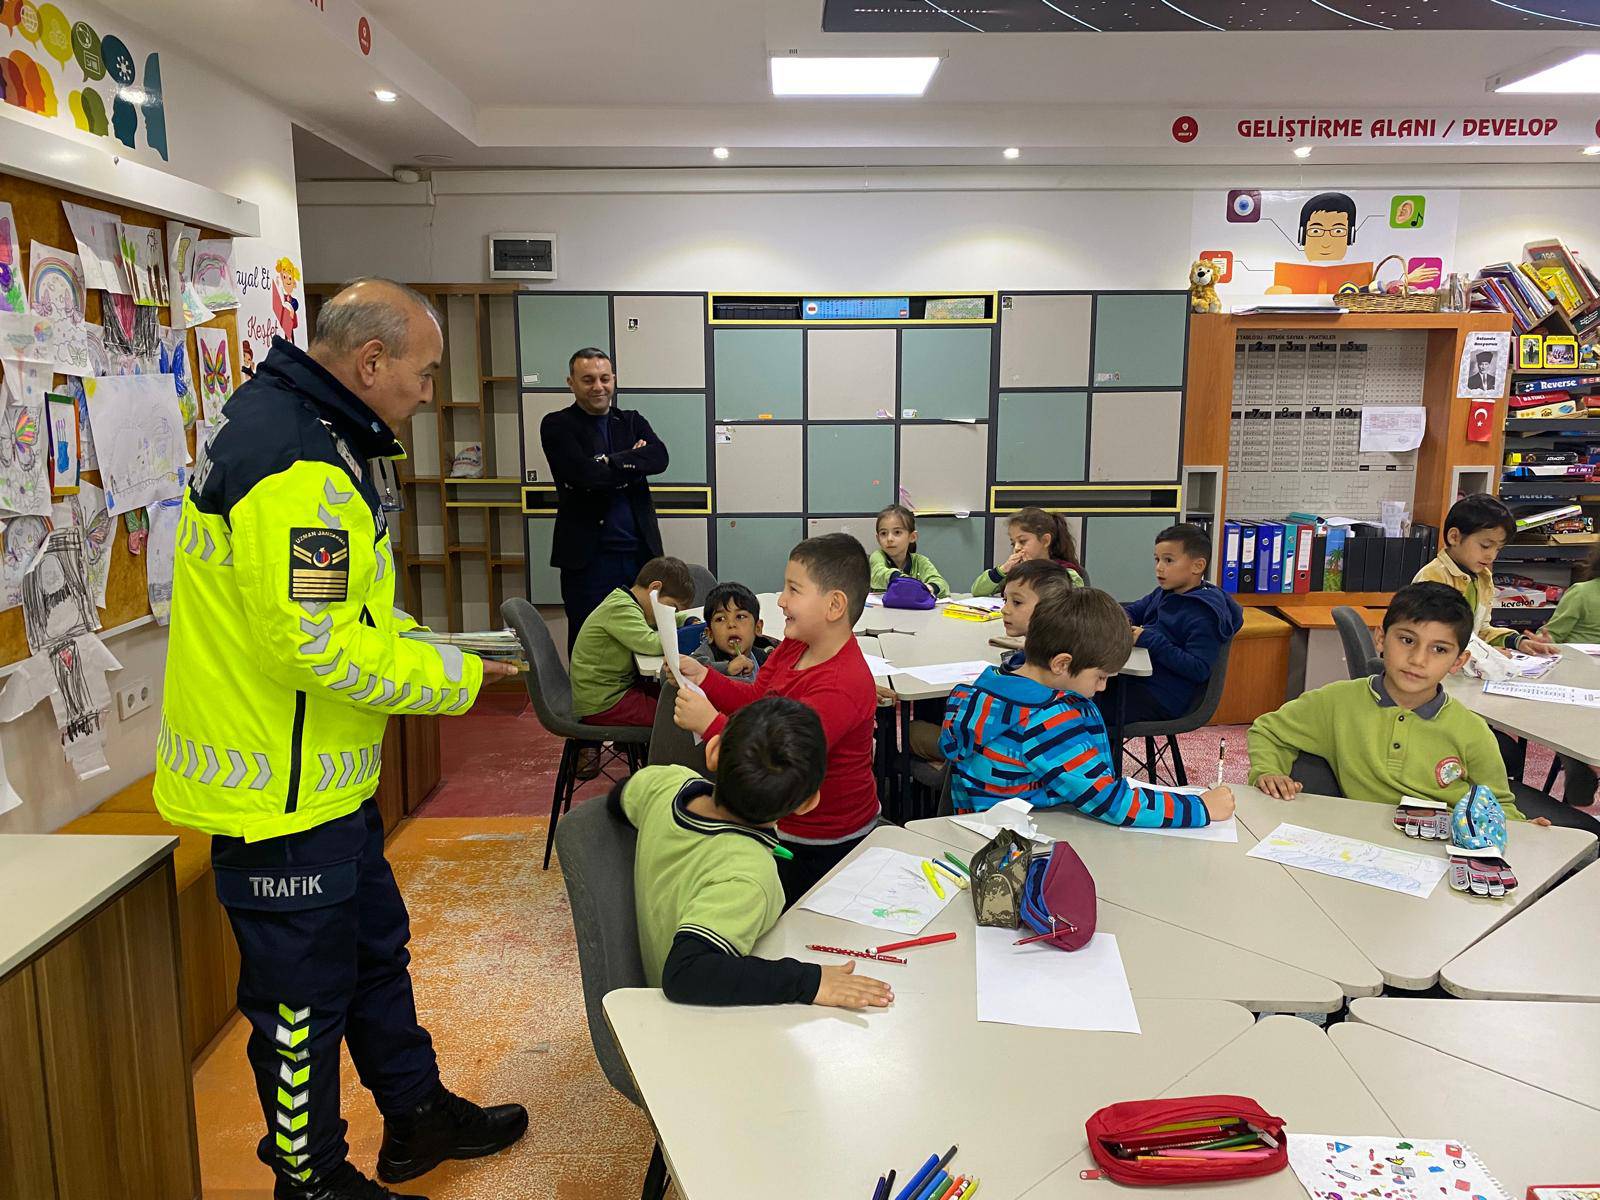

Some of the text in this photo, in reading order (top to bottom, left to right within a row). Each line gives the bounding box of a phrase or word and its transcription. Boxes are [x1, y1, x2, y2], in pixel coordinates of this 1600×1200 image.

[1237, 115, 1558, 142] GELİŞTİRME ALANI / DEVELOP
[236, 266, 259, 295] ayal
[1540, 379, 1578, 390] Reverse
